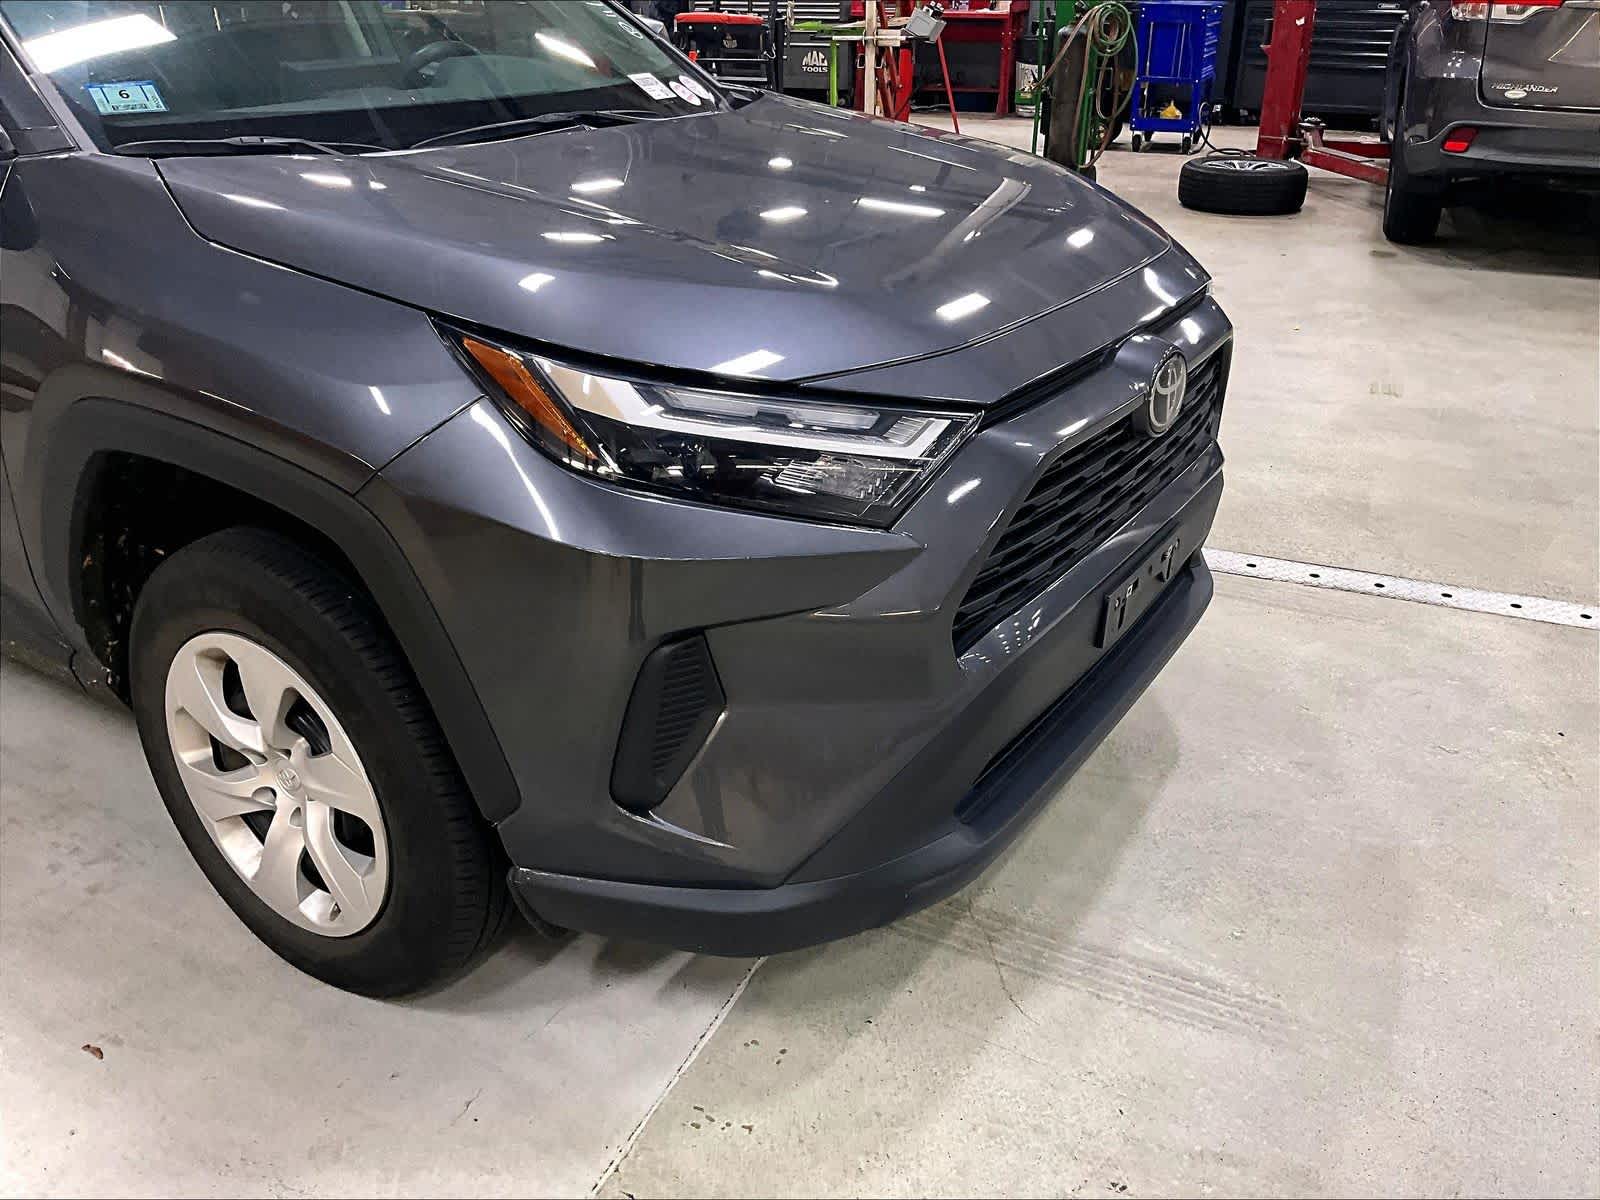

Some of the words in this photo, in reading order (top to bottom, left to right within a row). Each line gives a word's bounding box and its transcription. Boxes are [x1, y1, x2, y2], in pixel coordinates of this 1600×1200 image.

[802, 50, 828, 66] MAC
[1490, 83, 1559, 93] HIGHLANDER
[118, 89, 130, 99] 6
